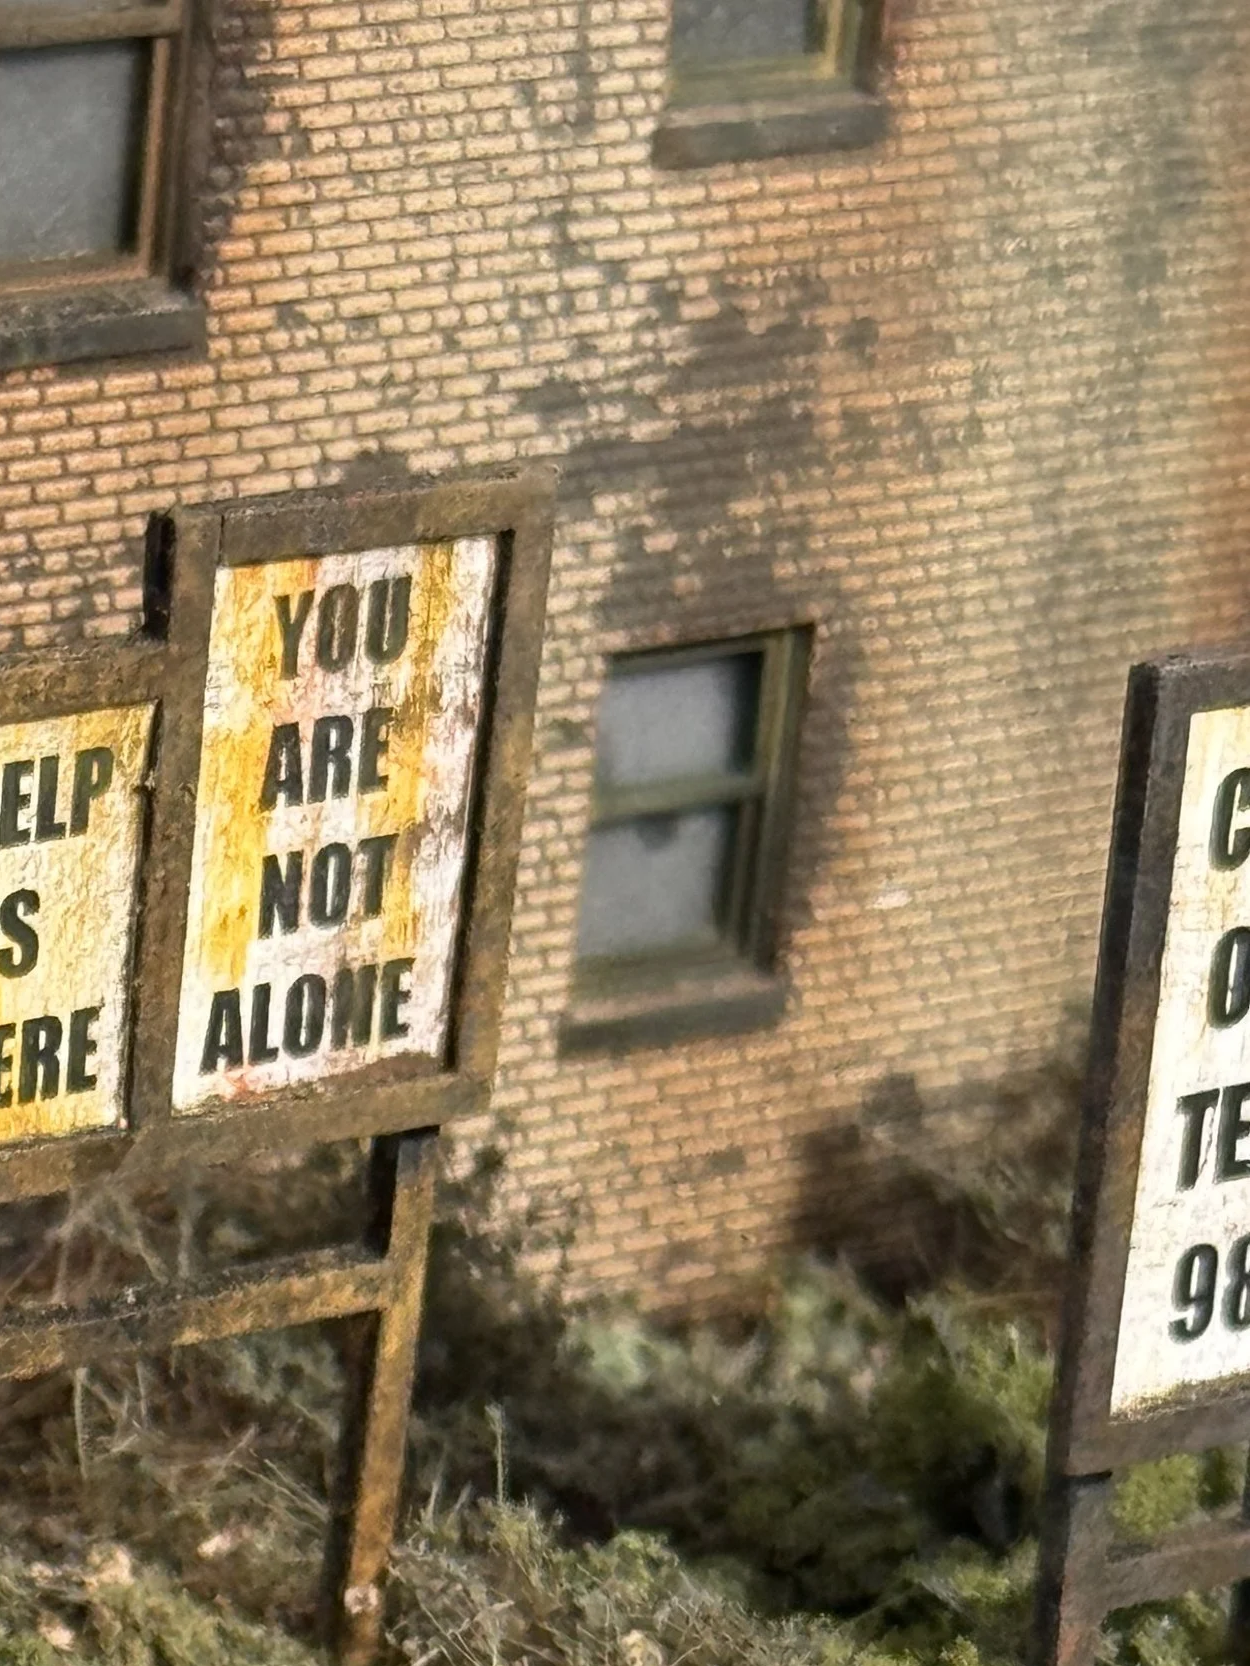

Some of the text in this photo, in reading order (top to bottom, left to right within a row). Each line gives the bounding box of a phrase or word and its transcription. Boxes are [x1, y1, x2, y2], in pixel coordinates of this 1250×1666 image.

[274, 576, 412, 680] YOU
[260, 707, 394, 811] ARE
[259, 834, 399, 940] NOT
[199, 957, 416, 1075] ALONE
[1175, 1082, 1250, 1194] TE
